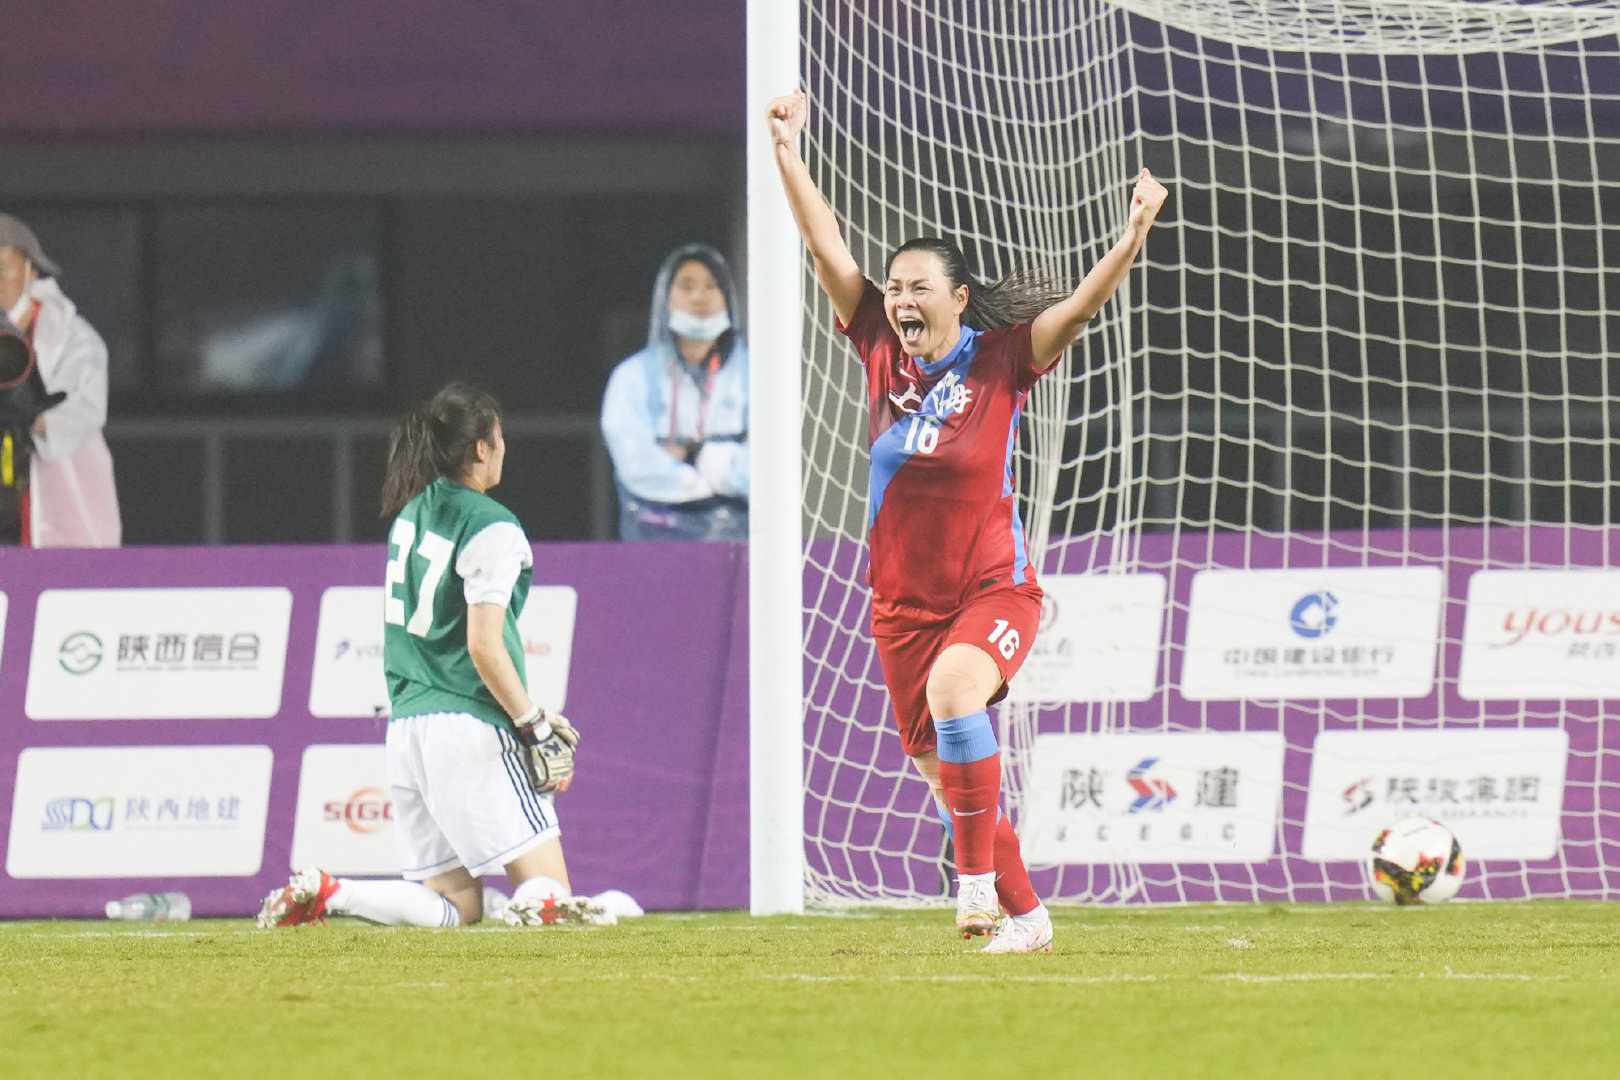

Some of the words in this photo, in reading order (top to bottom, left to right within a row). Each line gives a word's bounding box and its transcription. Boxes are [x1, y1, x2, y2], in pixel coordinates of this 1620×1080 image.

[903, 415, 941, 455] 16
[384, 517, 455, 638] 27
[117, 632, 261, 664] 陕西信合
[987, 618, 1020, 660] 16
